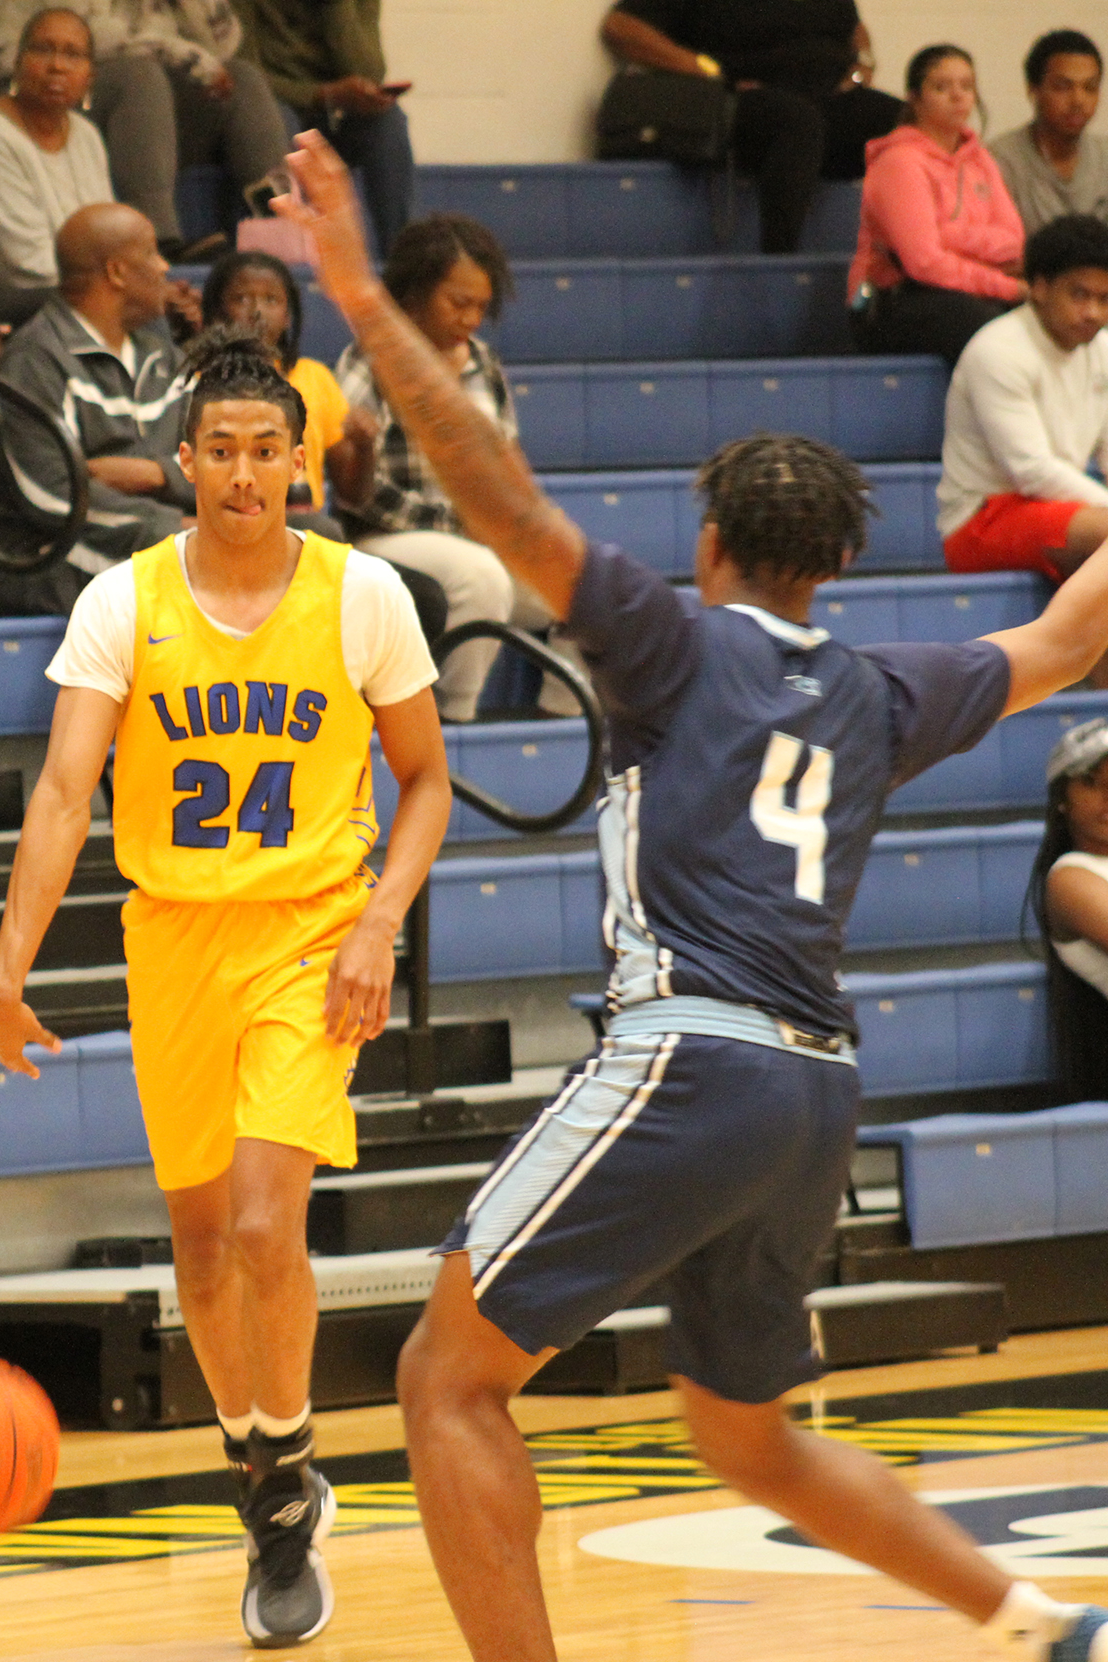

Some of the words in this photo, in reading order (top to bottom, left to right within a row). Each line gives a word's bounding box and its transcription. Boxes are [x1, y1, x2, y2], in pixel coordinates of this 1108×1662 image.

[149, 680, 328, 743] LIONS
[172, 759, 295, 849] 24
[750, 729, 834, 906] 4
